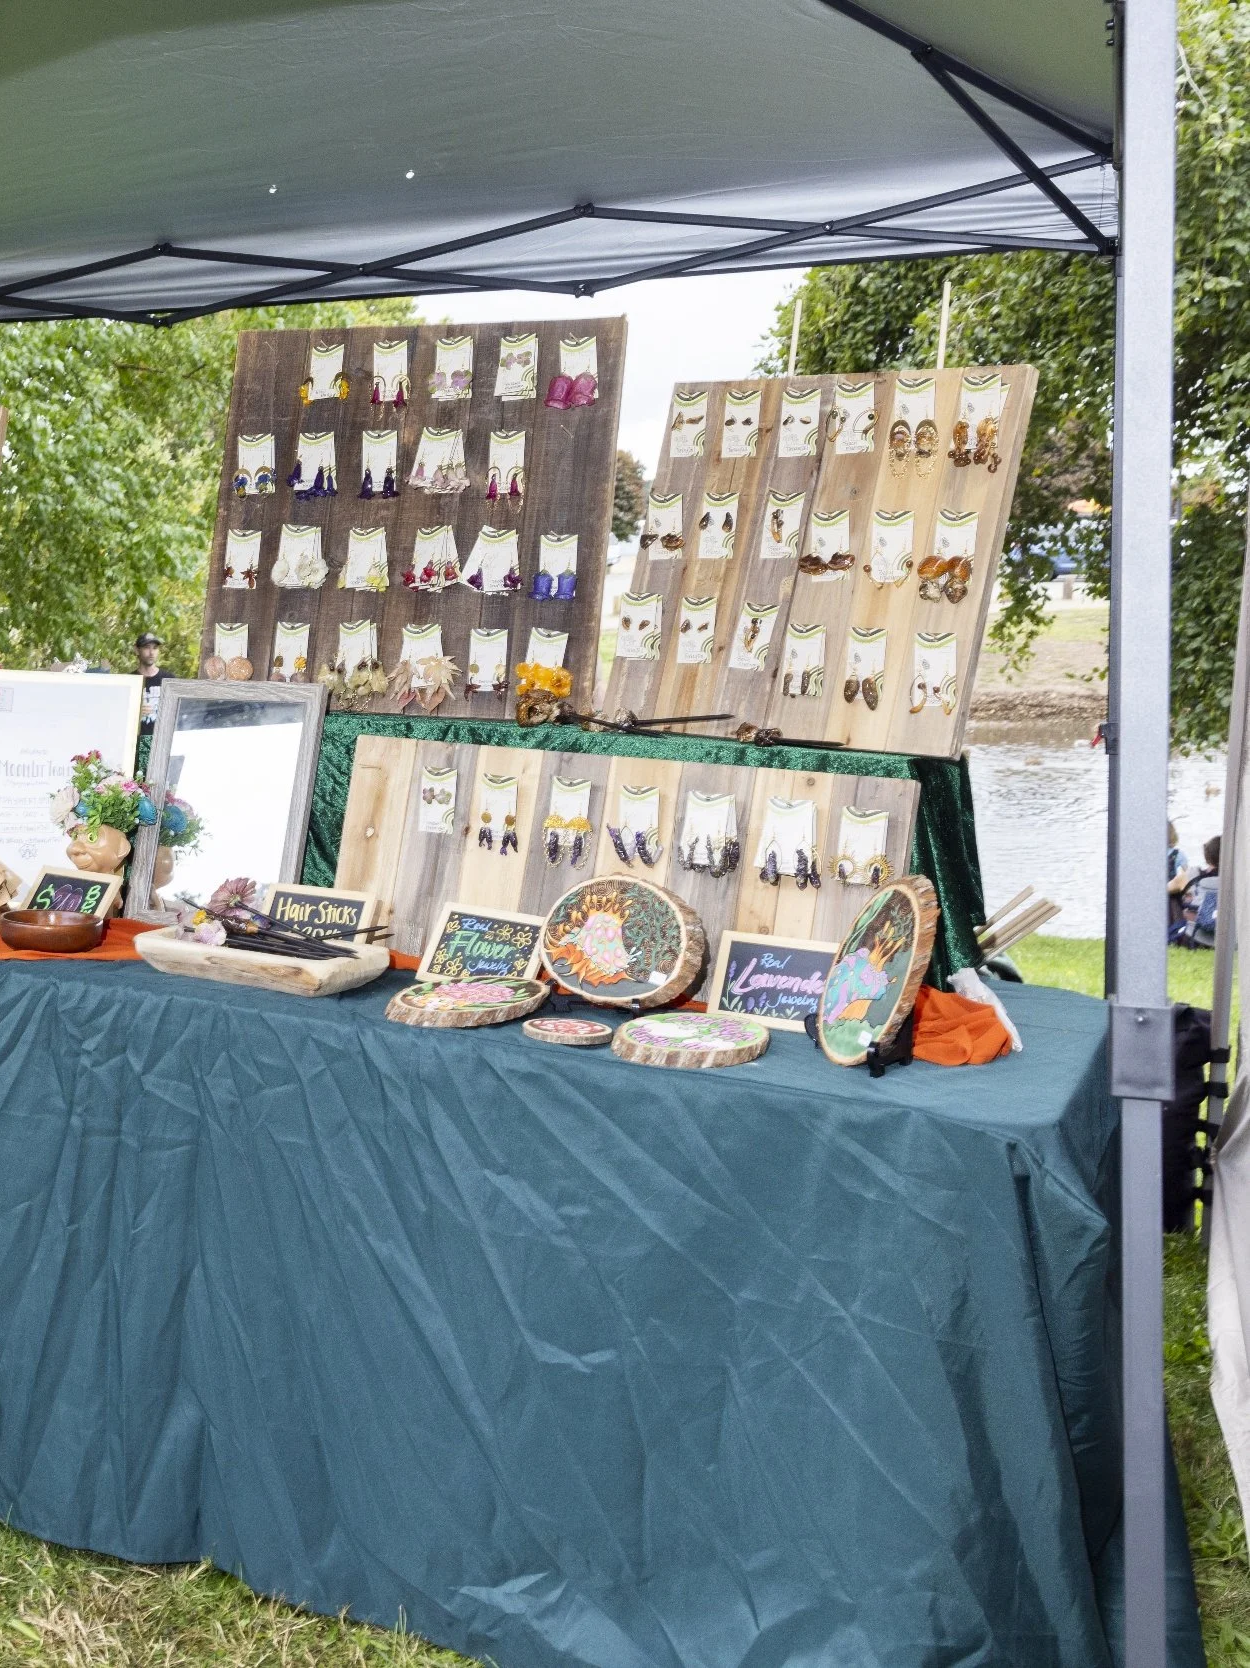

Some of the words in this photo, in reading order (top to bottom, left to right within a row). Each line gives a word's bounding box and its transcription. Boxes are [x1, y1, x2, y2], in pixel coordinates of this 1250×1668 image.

[276, 897, 317, 922] Hair
[314, 901, 358, 926] Sticks
[461, 918, 492, 931] Real
[447, 930, 517, 959] Flower
[760, 952, 792, 969] Real
[730, 957, 826, 995] Lavende
[766, 992, 819, 1014] Jewelry
